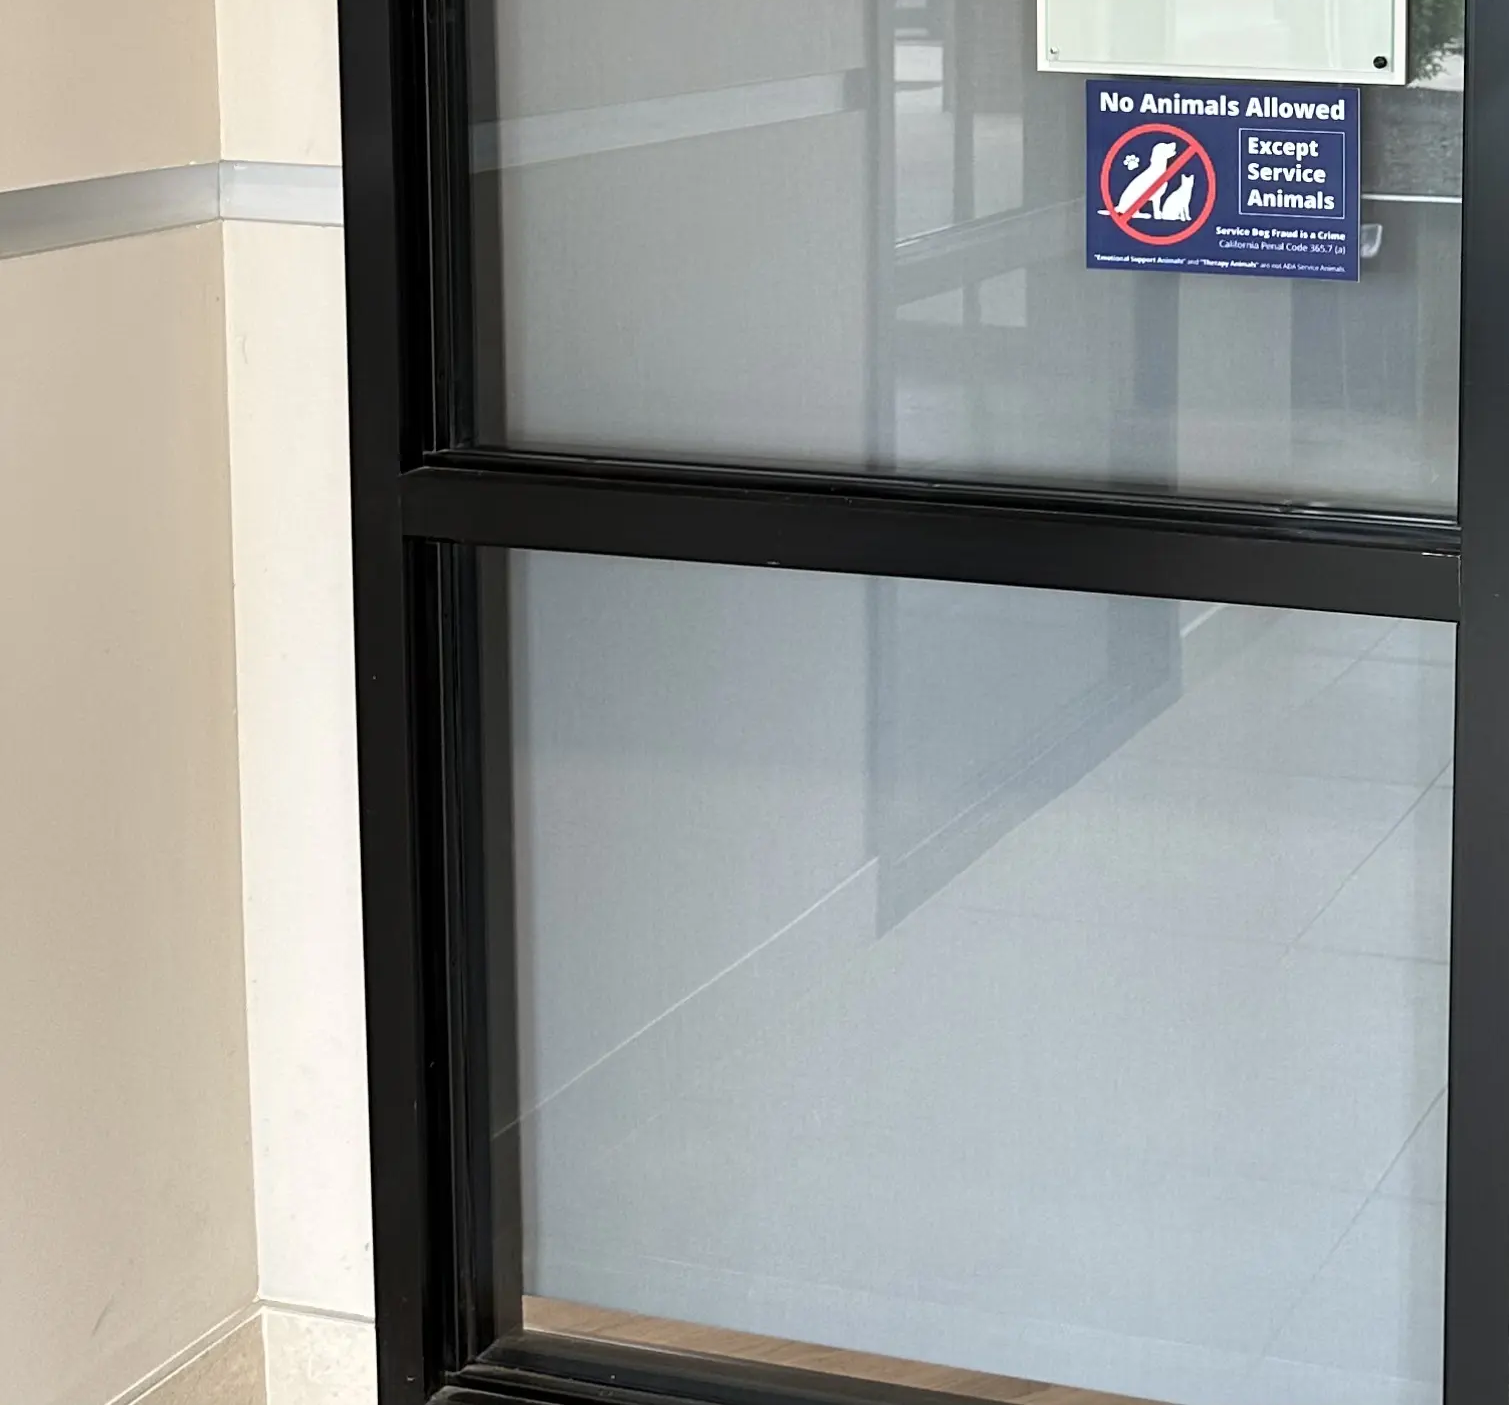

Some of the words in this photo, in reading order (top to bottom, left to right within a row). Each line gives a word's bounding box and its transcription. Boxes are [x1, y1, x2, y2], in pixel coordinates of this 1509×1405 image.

[1100, 92, 1133, 113] No
[1140, 93, 1239, 117] Animals
[1245, 97, 1345, 120] Allowed
[1248, 137, 1318, 161] Except
[1247, 162, 1326, 184] Service
[1247, 189, 1335, 210] Animals
[1215, 226, 1250, 236] Service
[1252, 228, 1270, 239] Dog
[1271, 228, 1299, 239] Fraud
[1300, 230, 1308, 239] is
[1318, 230, 1346, 241] Crime
[1218, 240, 1260, 250] California
[1261, 242, 1284, 251] Penal
[1286, 243, 1308, 253] Code
[1310, 243, 1332, 253] 365.7
[1334, 245, 1346, 255] (a)
